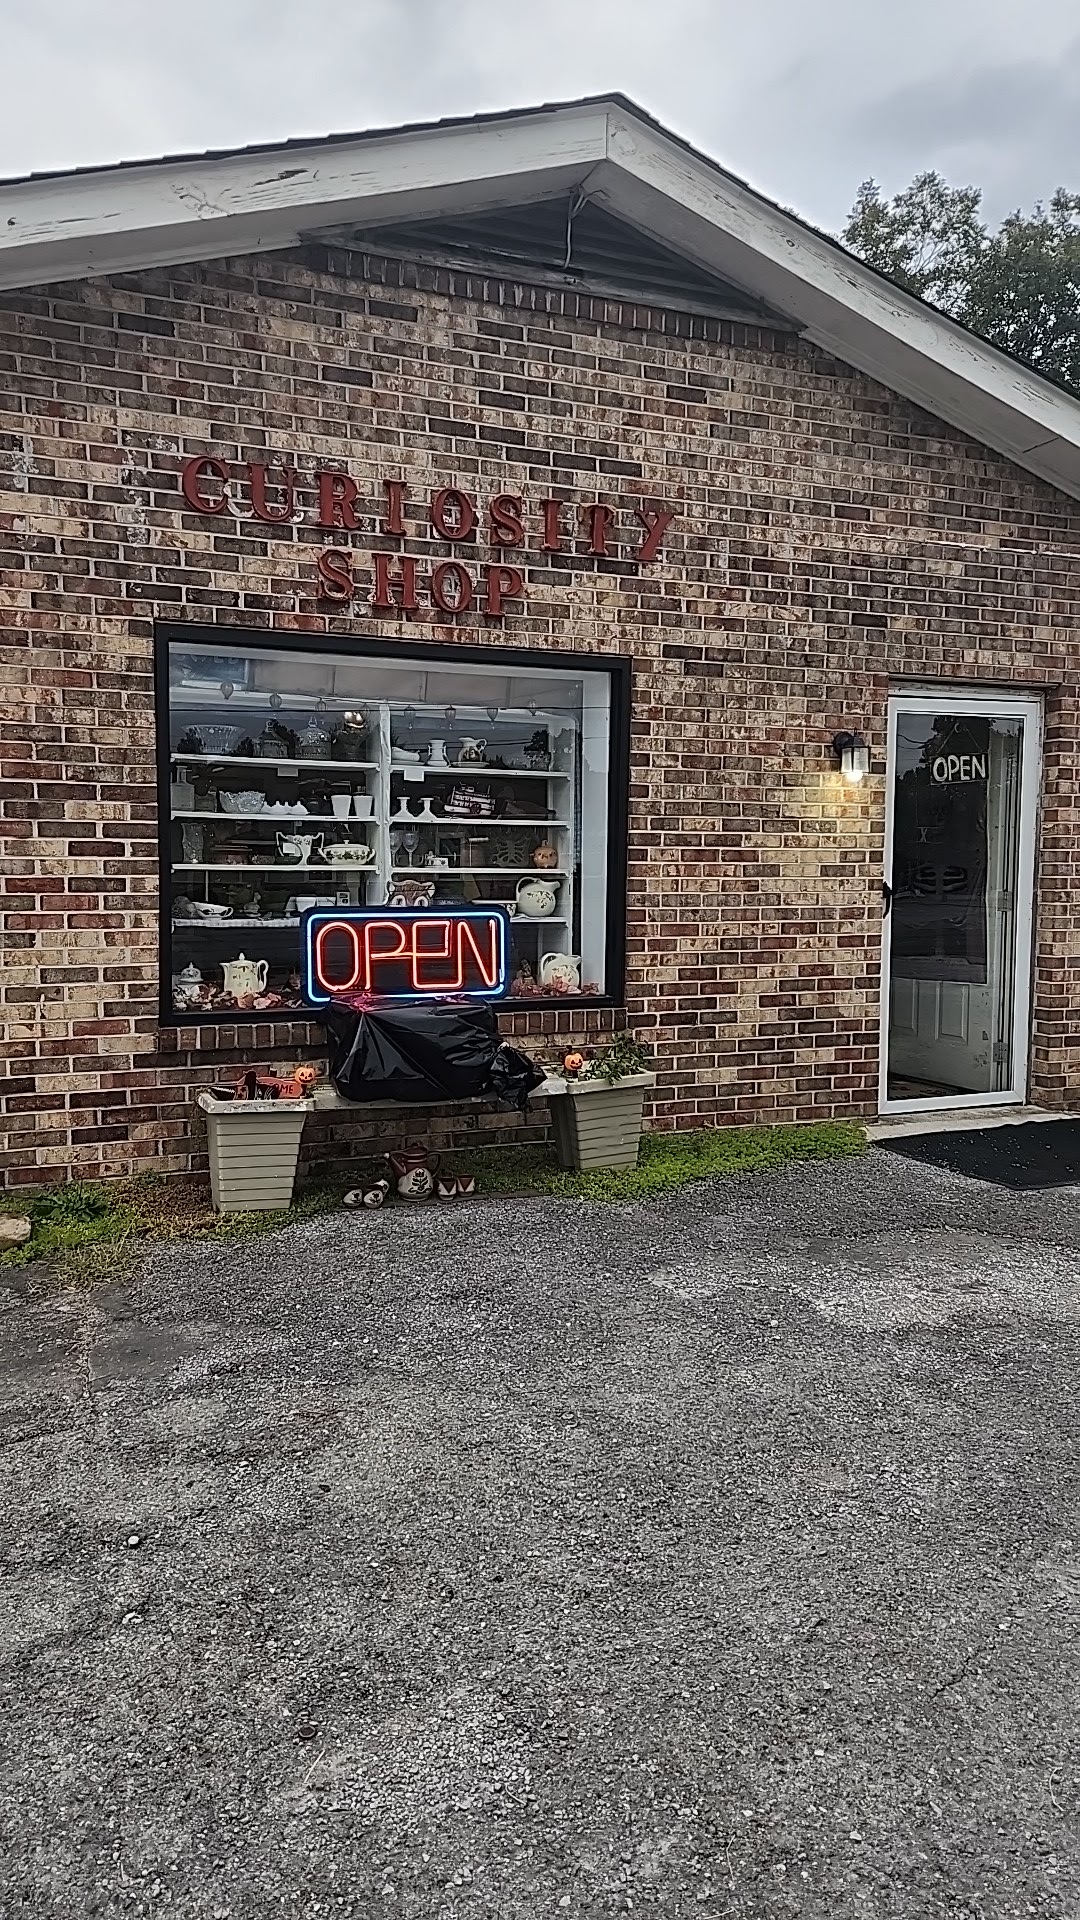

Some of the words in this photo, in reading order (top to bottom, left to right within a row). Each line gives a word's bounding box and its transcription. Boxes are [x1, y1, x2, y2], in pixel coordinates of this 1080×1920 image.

[182, 456, 675, 562] CURIOSITY
[316, 549, 523, 617] SHOP
[933, 754, 986, 781] OPEN
[316, 919, 497, 992] OPEN
